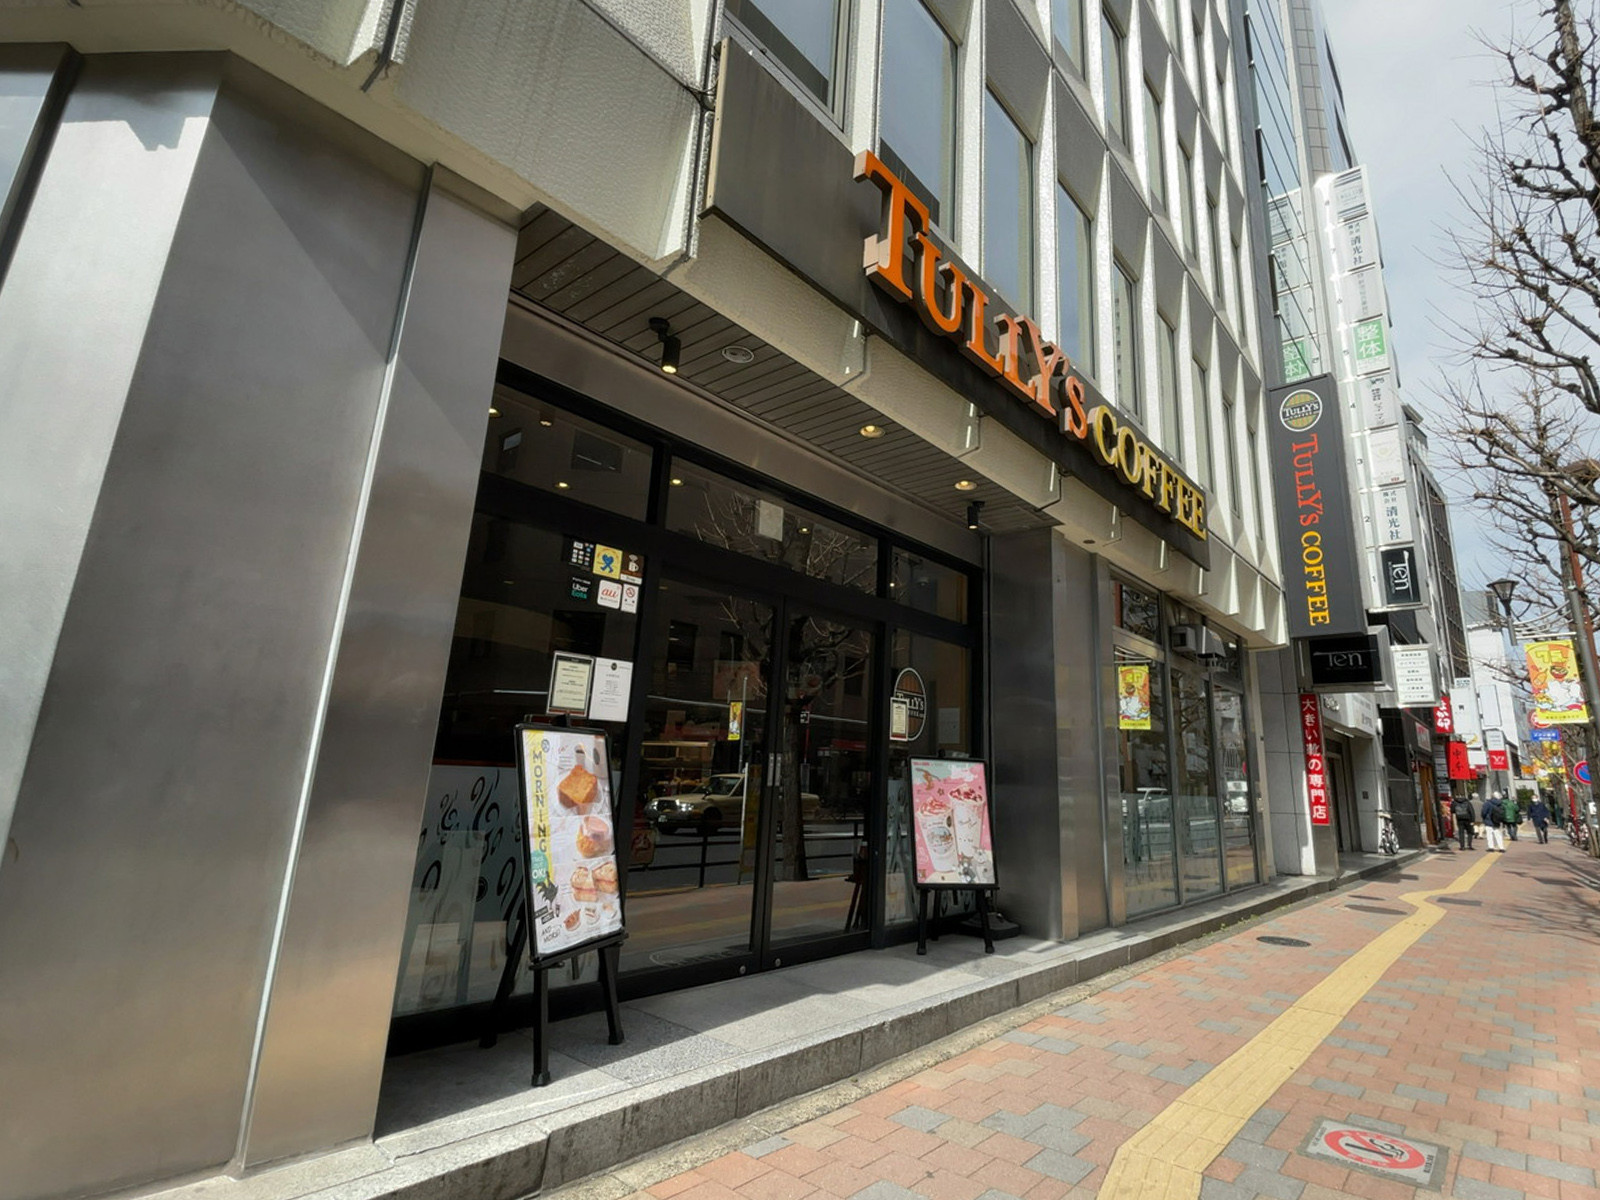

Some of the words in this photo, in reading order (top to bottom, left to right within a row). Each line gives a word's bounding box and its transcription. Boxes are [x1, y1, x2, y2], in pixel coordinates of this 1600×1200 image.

[853, 149, 1088, 440] TULLY'S
[1088, 405, 1207, 541] COFFEE
[1357, 324, 1380, 358] 整体
[1283, 402, 1319, 417] TULLY'S
[1292, 433, 1323, 527] TULLY'S
[572, 583, 589, 592] Uber
[601, 588, 619, 598] au
[1301, 531, 1330, 626] COFFEE
[1392, 551, 1413, 600] Ten
[533, 751, 547, 853] MORNING
[532, 869, 546, 879] OK!
